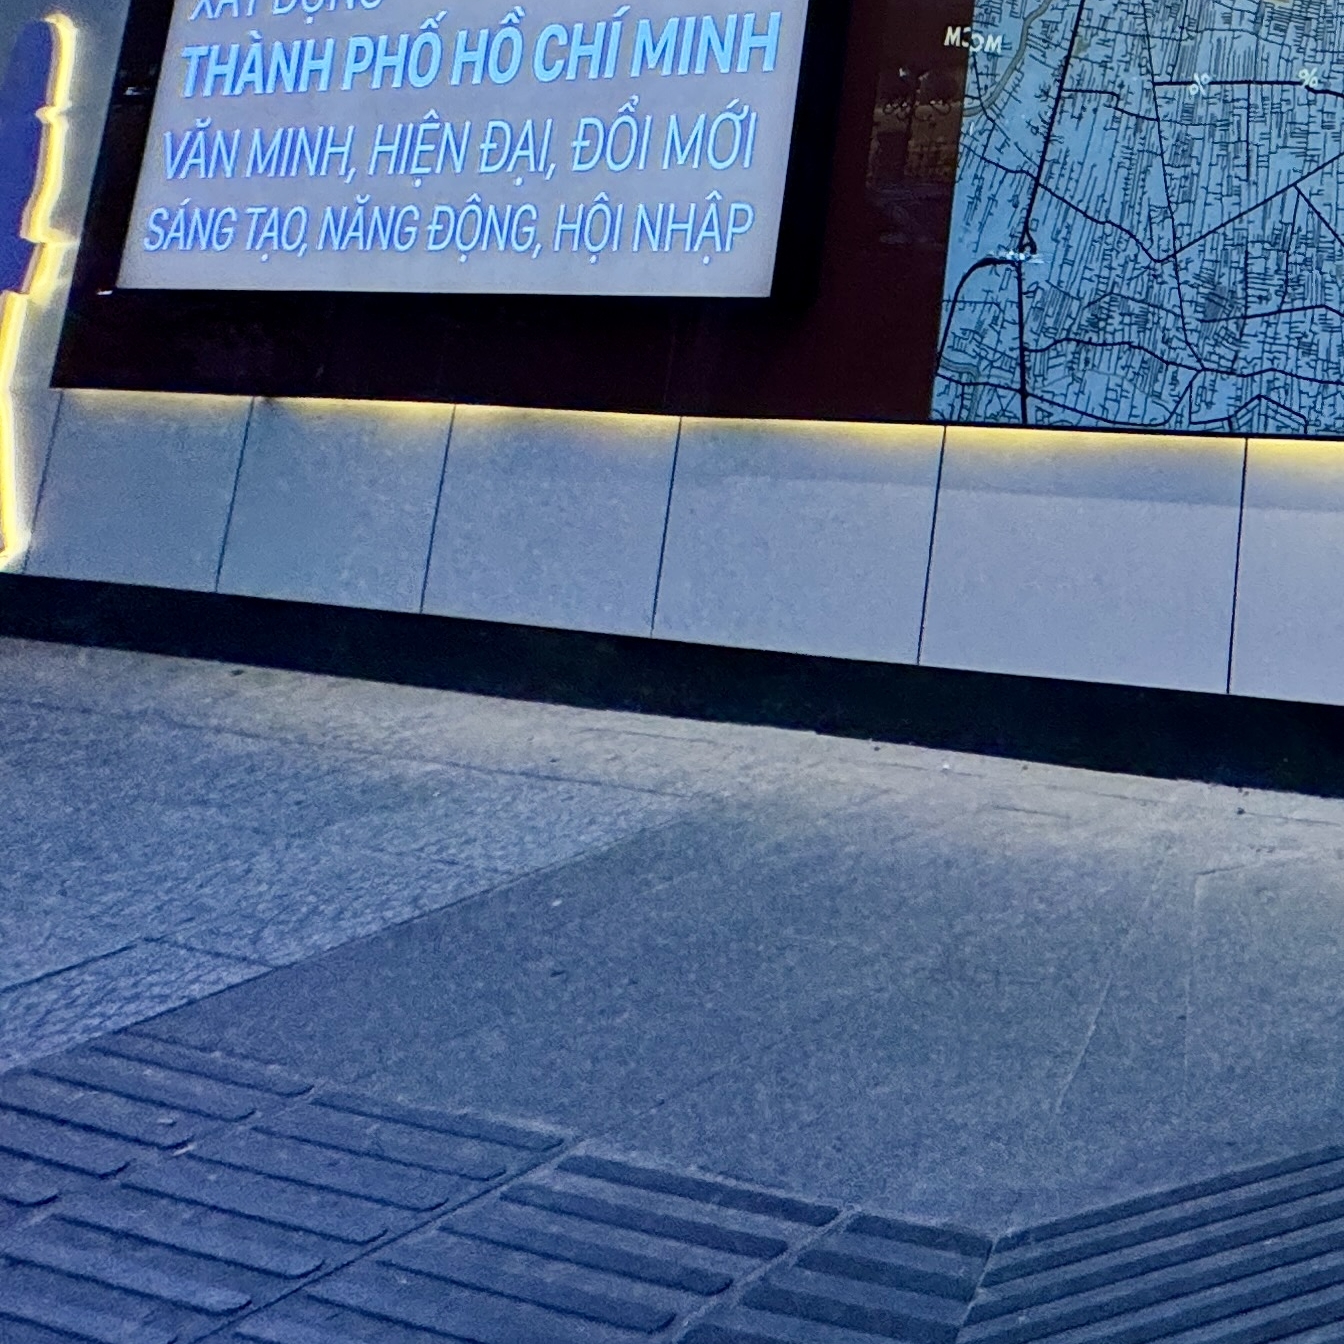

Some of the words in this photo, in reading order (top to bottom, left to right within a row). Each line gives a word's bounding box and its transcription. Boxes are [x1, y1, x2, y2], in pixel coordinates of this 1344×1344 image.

[181, 30, 335, 98] THÀNH
[341, 10, 448, 90] PHỐ
[449, 5, 526, 87] HỒ
[532, 5, 631, 83] CHÍ
[630, 11, 782, 78] MINH
[163, 117, 241, 180] VĂN
[245, 124, 355, 184] MINH,
[368, 109, 471, 188] HIỆN
[478, 118, 556, 186] ĐẠI,
[571, 94, 653, 172] ĐỔI
[663, 98, 758, 170] MỚI
[144, 197, 237, 252] SÁNG
[245, 205, 308, 261] TẠO,
[317, 193, 419, 252] NĂNG
[426, 193, 542, 263] ĐỘNG,
[553, 191, 623, 264] HỘI
[632, 190, 755, 265] NHẬP
